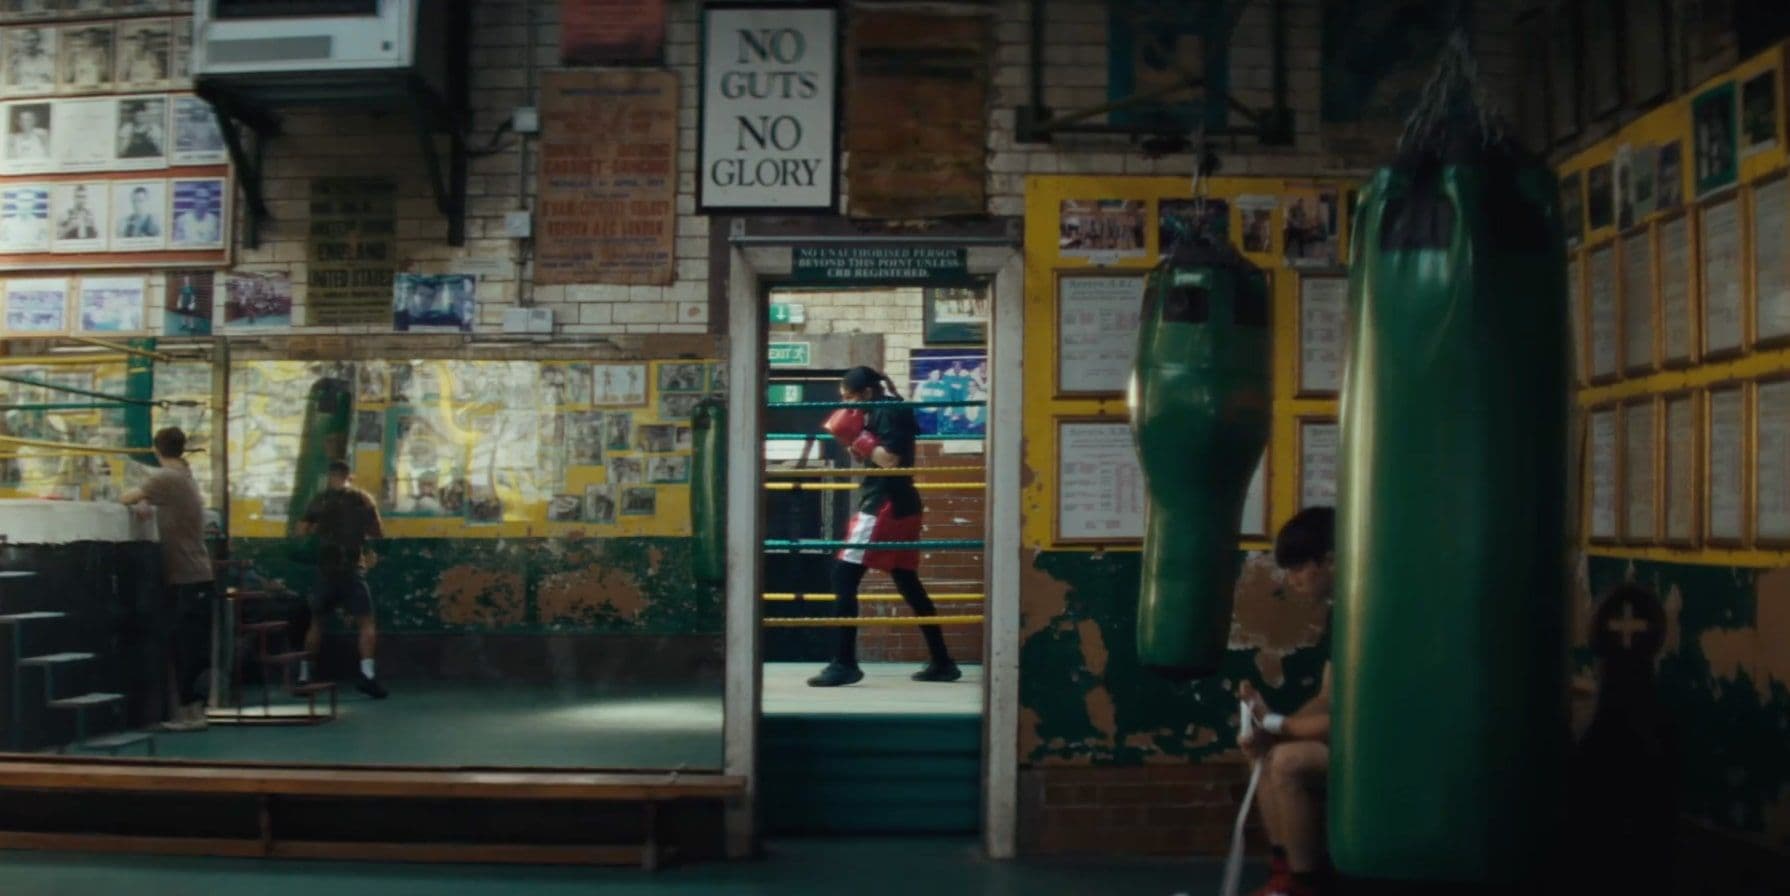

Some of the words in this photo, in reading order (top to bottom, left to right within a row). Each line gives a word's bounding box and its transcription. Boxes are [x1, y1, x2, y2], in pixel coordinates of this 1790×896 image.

[736, 28, 807, 64] NO
[720, 71, 819, 99] GUTS
[735, 115, 802, 151] NO
[711, 158, 822, 187] GLORY
[798, 257, 845, 267] BEYOND
[848, 257, 874, 267] THIS
[877, 257, 913, 267] POINT
[916, 257, 959, 267] UNLESS
[801, 248, 818, 257] NO
[913, 248, 957, 257] PERSON
[826, 268, 850, 278] CRB
